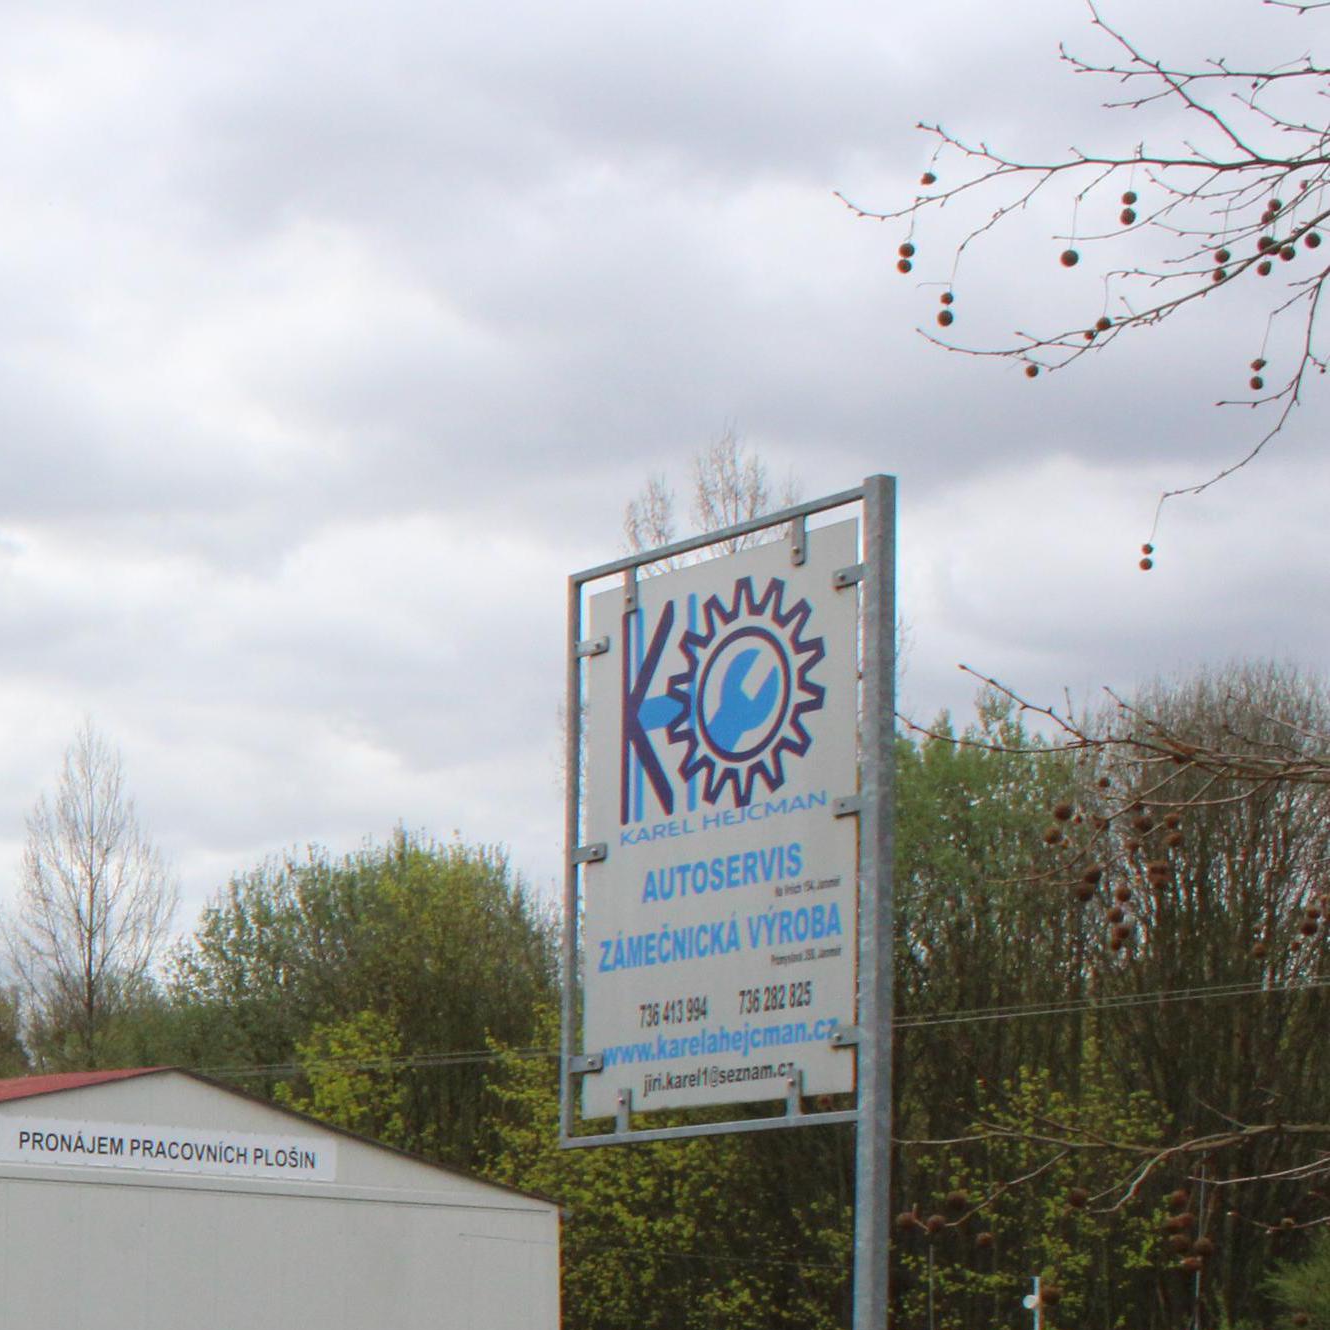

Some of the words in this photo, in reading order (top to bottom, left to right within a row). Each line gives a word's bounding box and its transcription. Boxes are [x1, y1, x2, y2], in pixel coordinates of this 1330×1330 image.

[620, 819, 694, 846] KAREL
[702, 790, 827, 830] HEJCMAN
[642, 842, 803, 903] AUTOSERVIS
[598, 911, 740, 973] ZÁMEČNICKÁ
[747, 902, 842, 949] VÝROBA
[639, 1003, 659, 1028] 736
[663, 999, 683, 1025] 413
[686, 996, 708, 1022] 994
[738, 989, 760, 1016] 736
[763, 984, 786, 1012] 282
[789, 980, 812, 1009] 825
[602, 1017, 839, 1069] www.karelahejcman.cz
[19, 1130, 124, 1156] PRONÁJEM
[130, 1139, 247, 1165] PRACOVNÍCH
[253, 1147, 316, 1169] PLOŠIN
